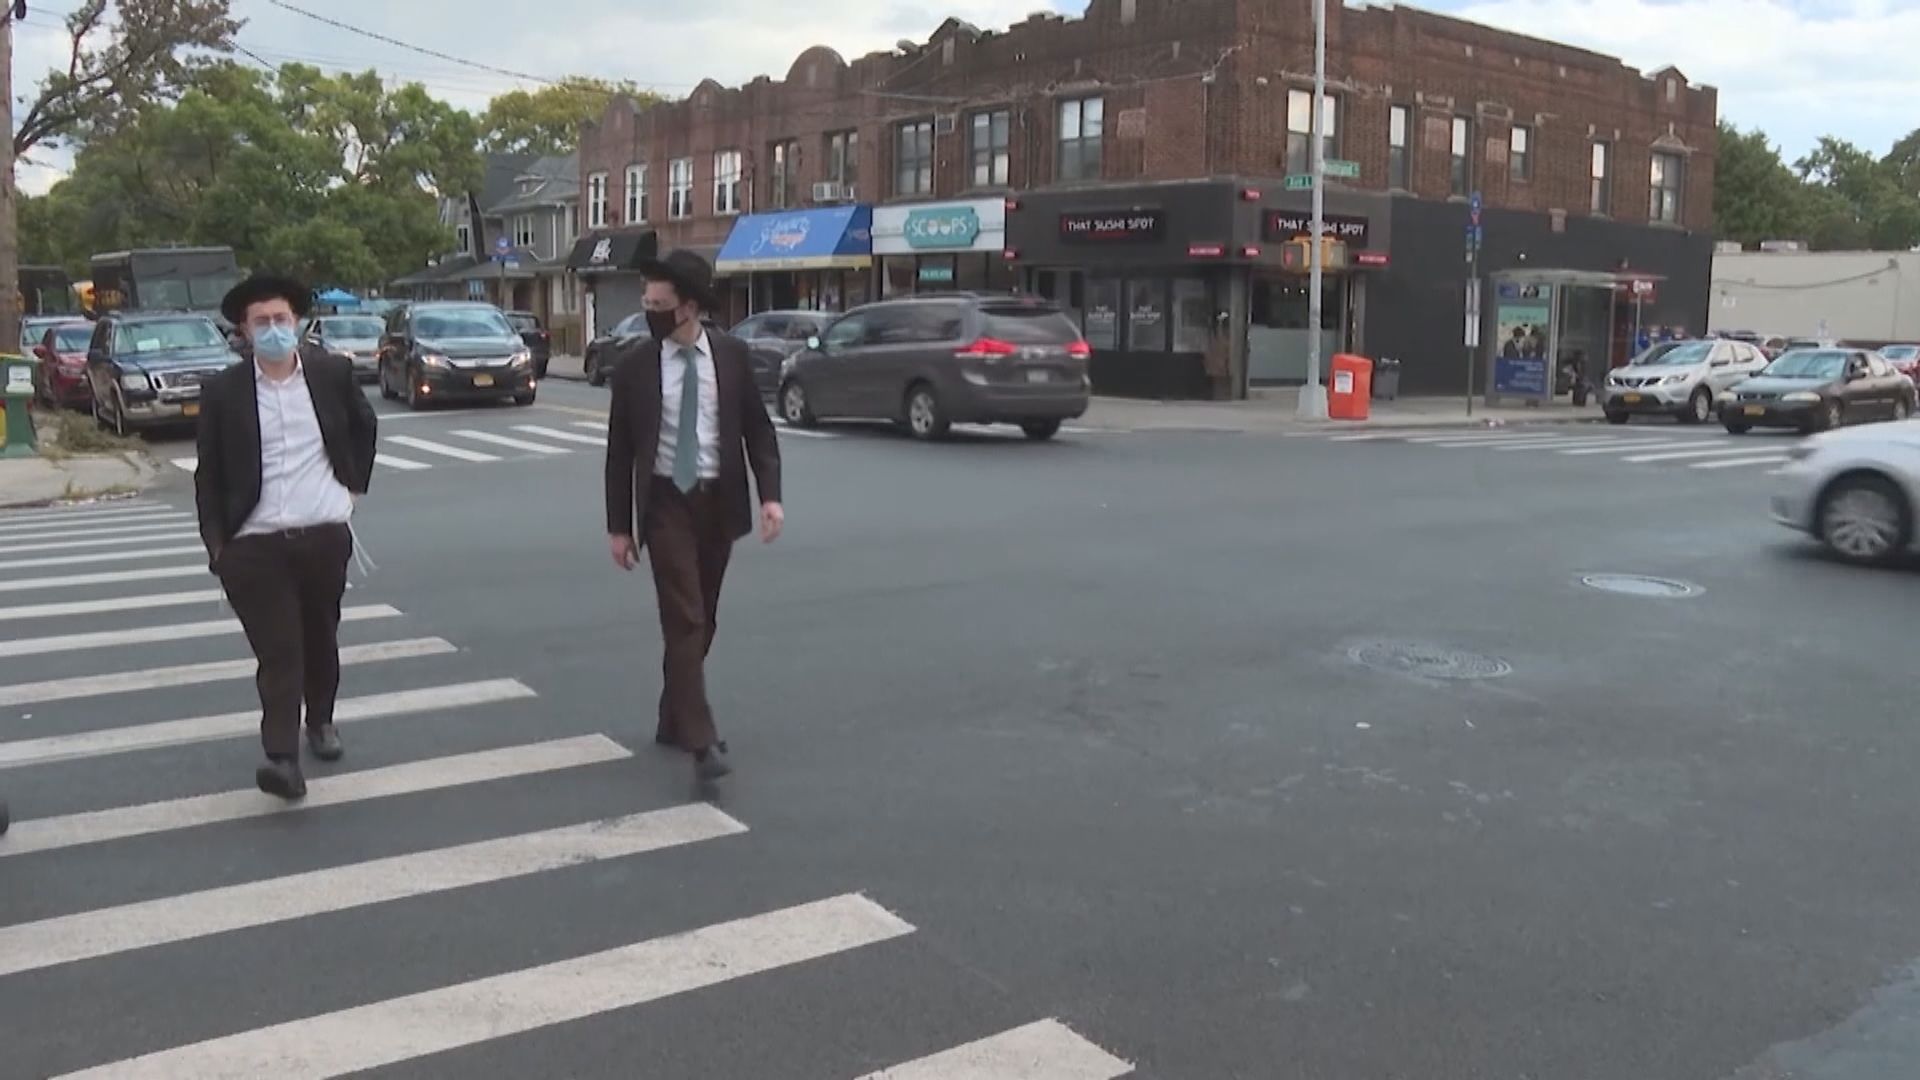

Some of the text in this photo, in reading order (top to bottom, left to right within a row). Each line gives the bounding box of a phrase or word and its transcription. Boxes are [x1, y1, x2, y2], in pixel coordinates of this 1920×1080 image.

[911, 216, 968, 236] SCOOPS
[1068, 217, 1155, 231] THAT SUSHI SPOT
[1277, 217, 1303, 231] THAT
[1339, 222, 1364, 236] SPOT
